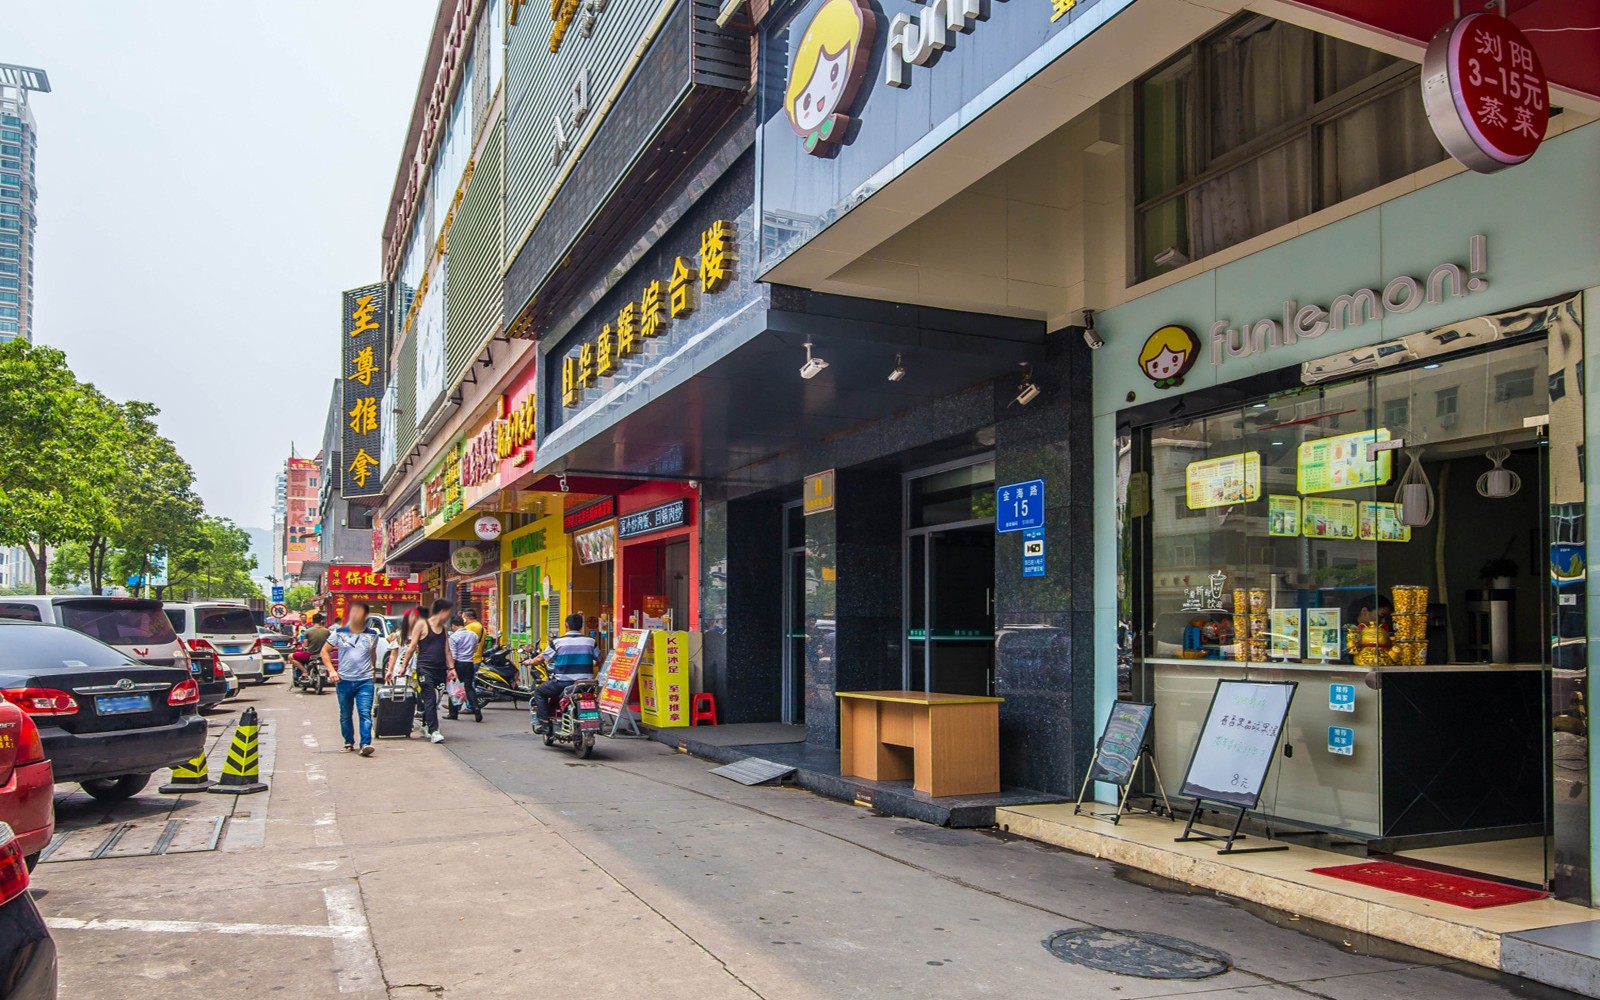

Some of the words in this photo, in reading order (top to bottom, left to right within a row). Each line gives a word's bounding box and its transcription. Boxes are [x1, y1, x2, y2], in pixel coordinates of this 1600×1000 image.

[1474, 29, 1534, 73] 浏阳
[1468, 58, 1543, 111] 3-15元
[1477, 95, 1540, 140] 蒸菜
[578, 219, 732, 389] 华盛辉综合楼
[1209, 234, 1489, 366] funlemon!
[348, 294, 380, 488] 至尊推拿
[1003, 484, 1038, 502] 金海路
[1013, 499, 1029, 518] 15
[479, 523, 500, 533] 蒸菜
[289, 543, 306, 551] KTV
[667, 637, 679, 674] K歌沐足
[1335, 685, 1349, 694] 推荐
[1335, 693, 1348, 701] 商家
[668, 684, 680, 721] 至尊推拿
[1334, 728, 1347, 737] 推荐
[1334, 736, 1347, 744] 商家
[1230, 773, 1250, 789] 8元
